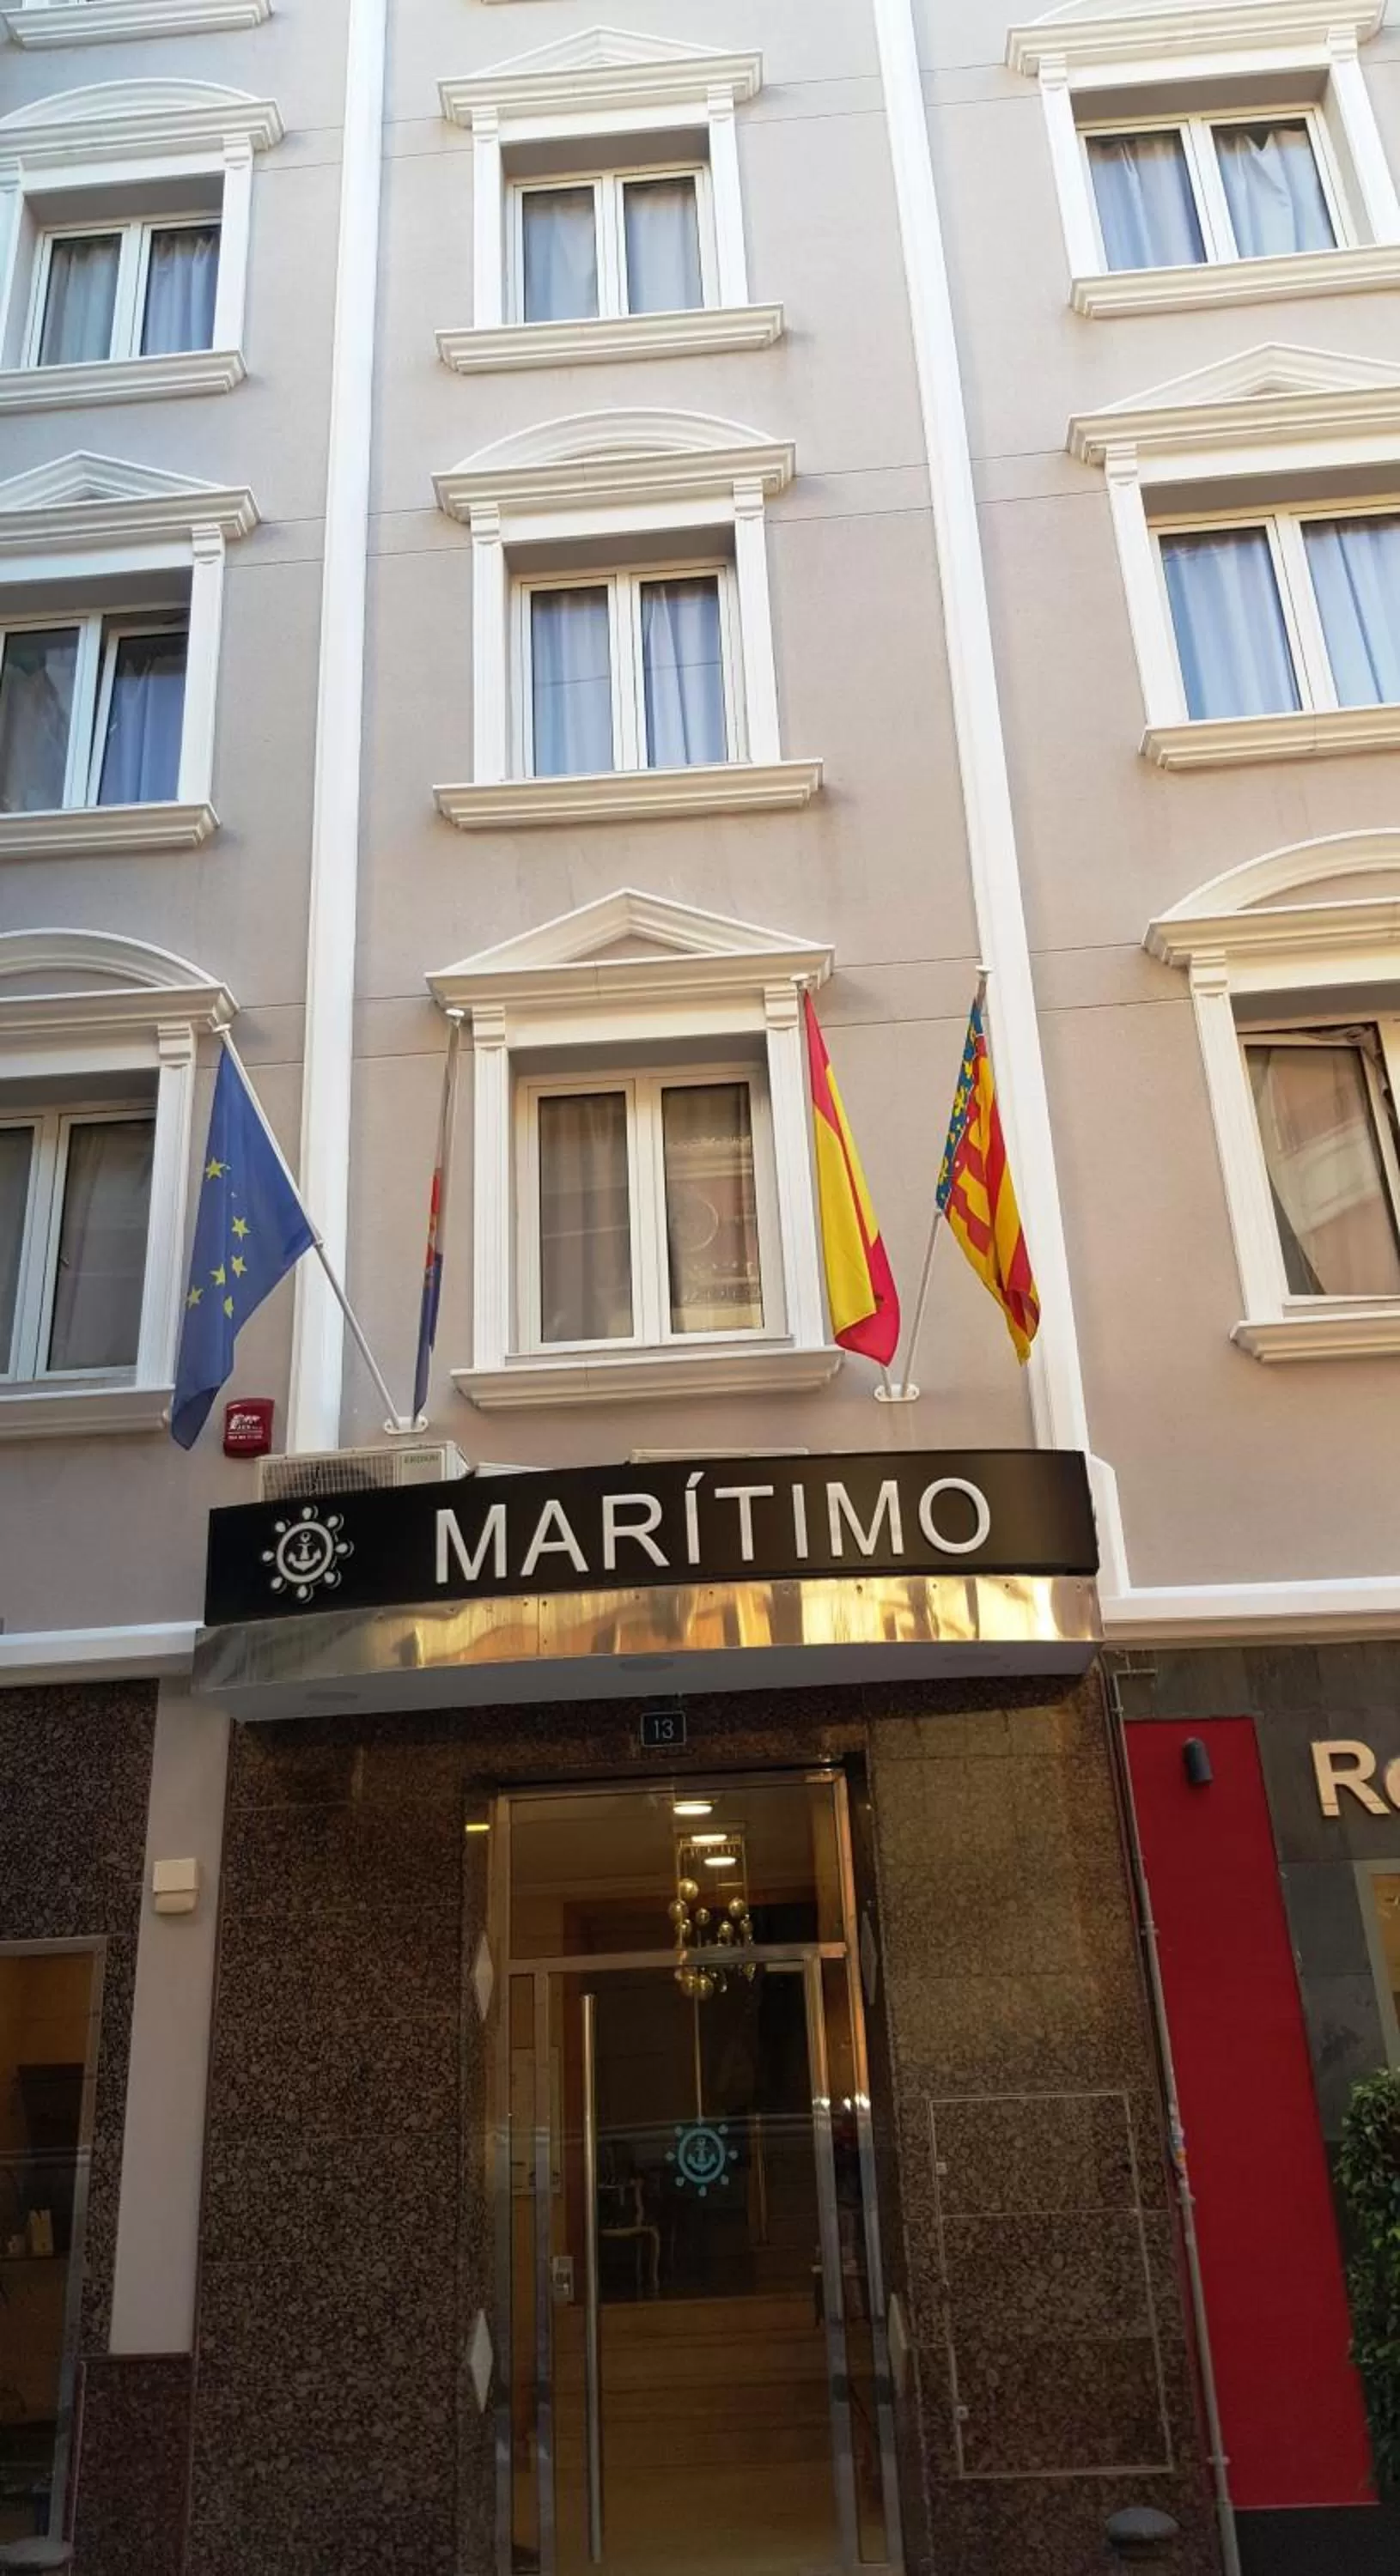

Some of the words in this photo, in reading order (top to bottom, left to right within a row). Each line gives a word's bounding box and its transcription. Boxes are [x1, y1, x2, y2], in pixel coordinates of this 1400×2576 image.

[435, 1471, 990, 1584] MARÍTIMO
[654, 1718, 674, 1740] 13
[1311, 1740, 1400, 1816] R
